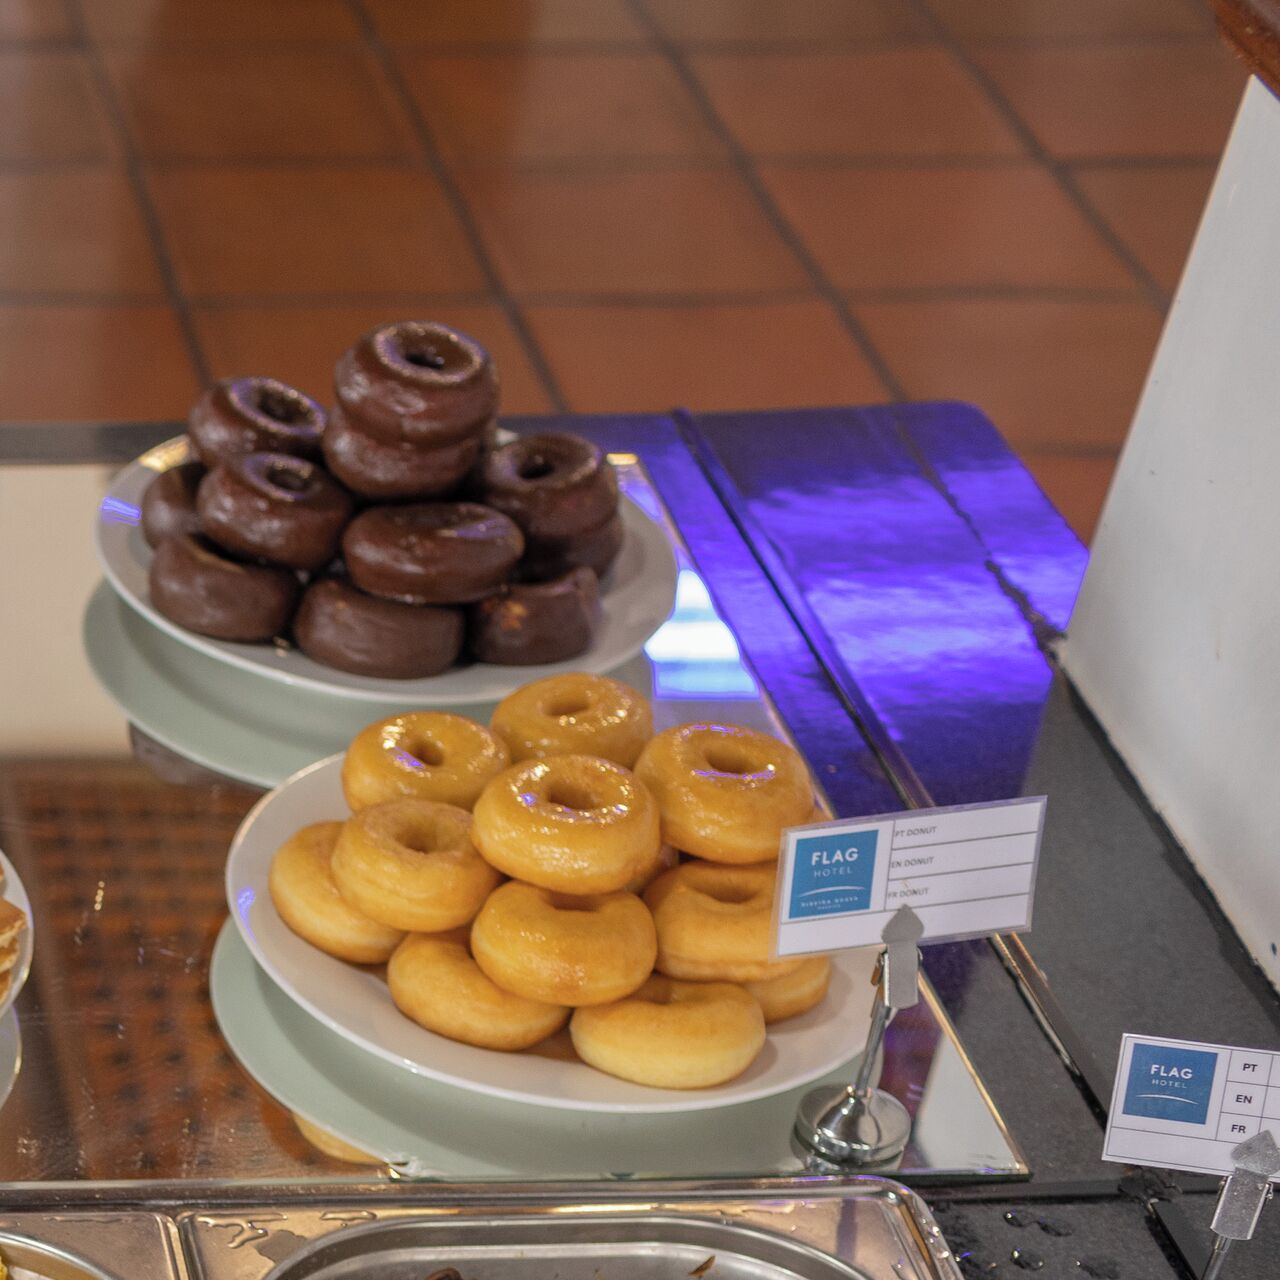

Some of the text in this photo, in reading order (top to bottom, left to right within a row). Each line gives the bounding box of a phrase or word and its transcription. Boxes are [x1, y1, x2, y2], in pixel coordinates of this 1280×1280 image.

[906, 826, 937, 837] DONUT
[811, 847, 859, 866] FLAG
[904, 856, 934, 867] DONUT
[814, 866, 853, 878] HOTEL
[899, 887, 929, 898] DONUT
[1151, 1064, 1193, 1079] FLAG
[1242, 1063, 1258, 1073] PT
[1151, 1079, 1187, 1089] HOTEL
[1236, 1094, 1252, 1104] EN
[1231, 1124, 1246, 1134] FR
